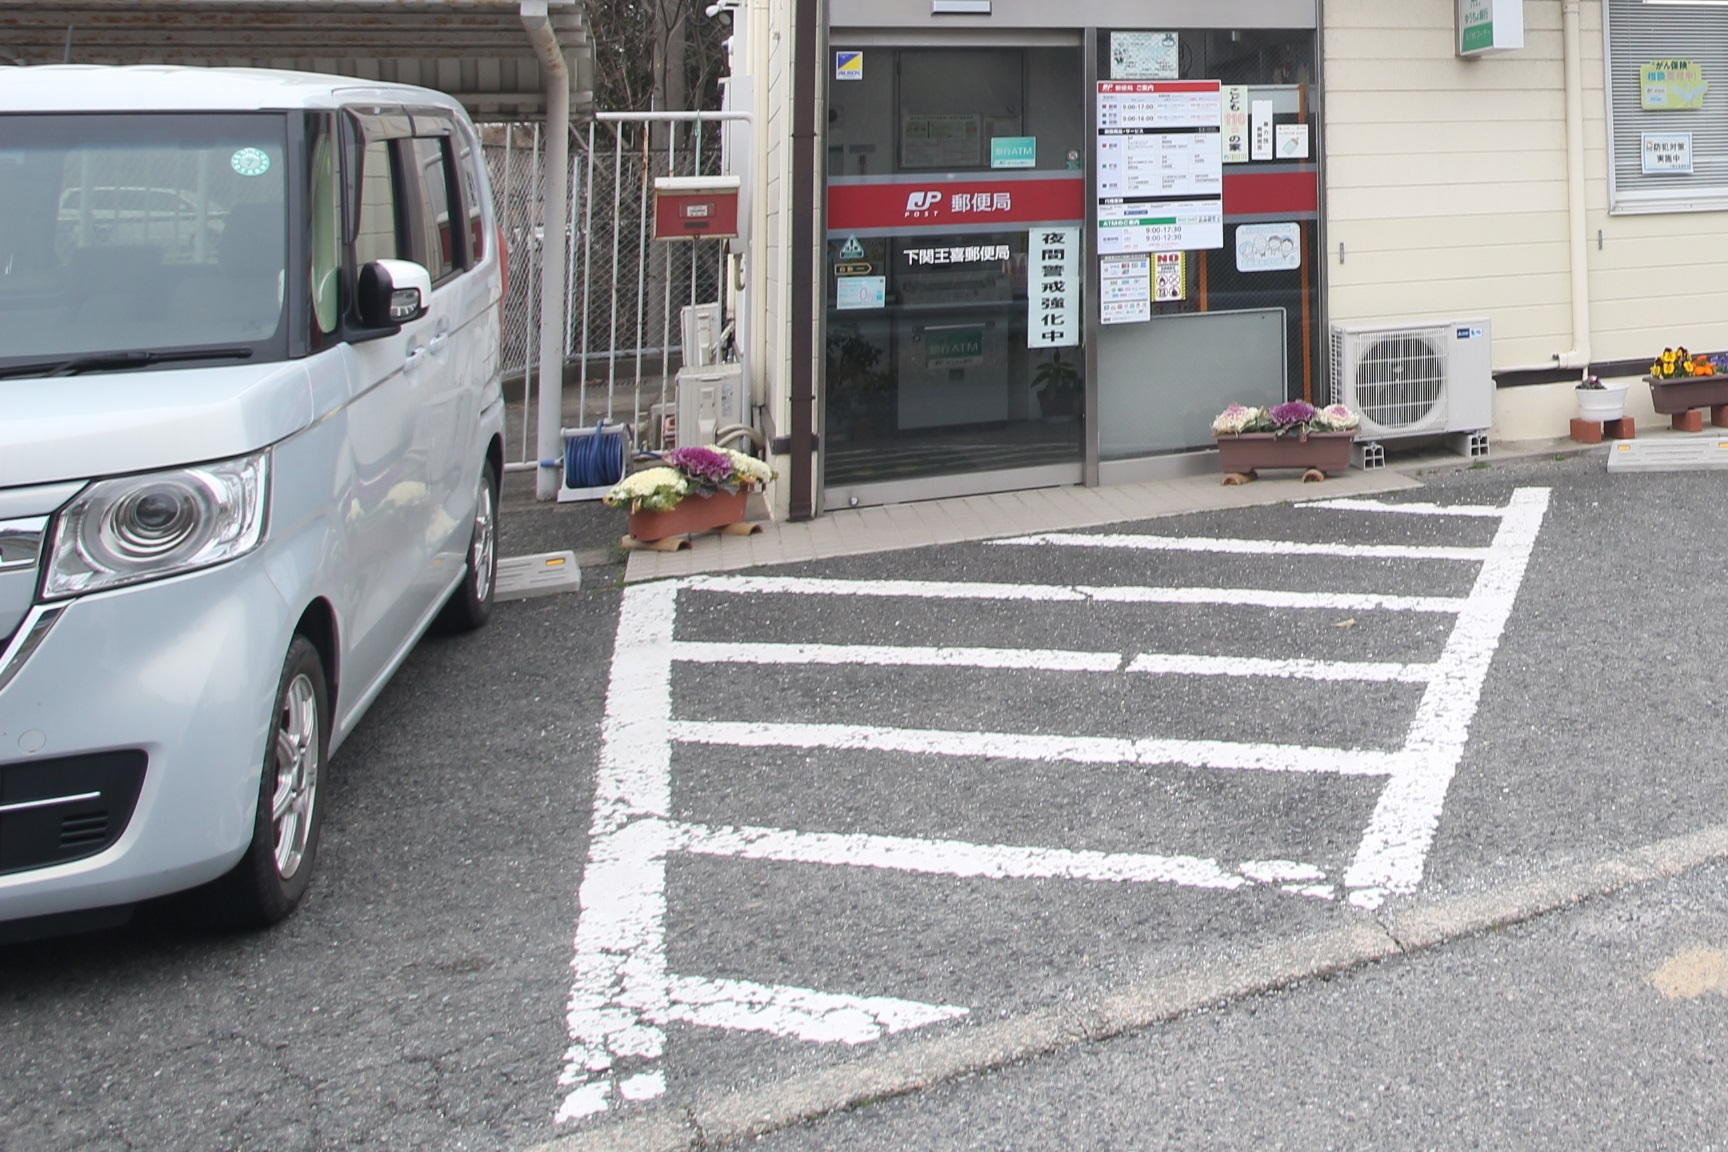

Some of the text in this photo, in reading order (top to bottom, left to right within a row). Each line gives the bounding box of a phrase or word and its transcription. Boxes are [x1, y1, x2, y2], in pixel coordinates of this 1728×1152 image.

[951, 192, 1012, 213] 郵便局
[904, 210, 939, 218] POST
[903, 244, 1010, 266] 下関王喜郵便局
[1157, 254, 1179, 263] NO
[1041, 231, 1066, 343] 夜間警戒強化中
